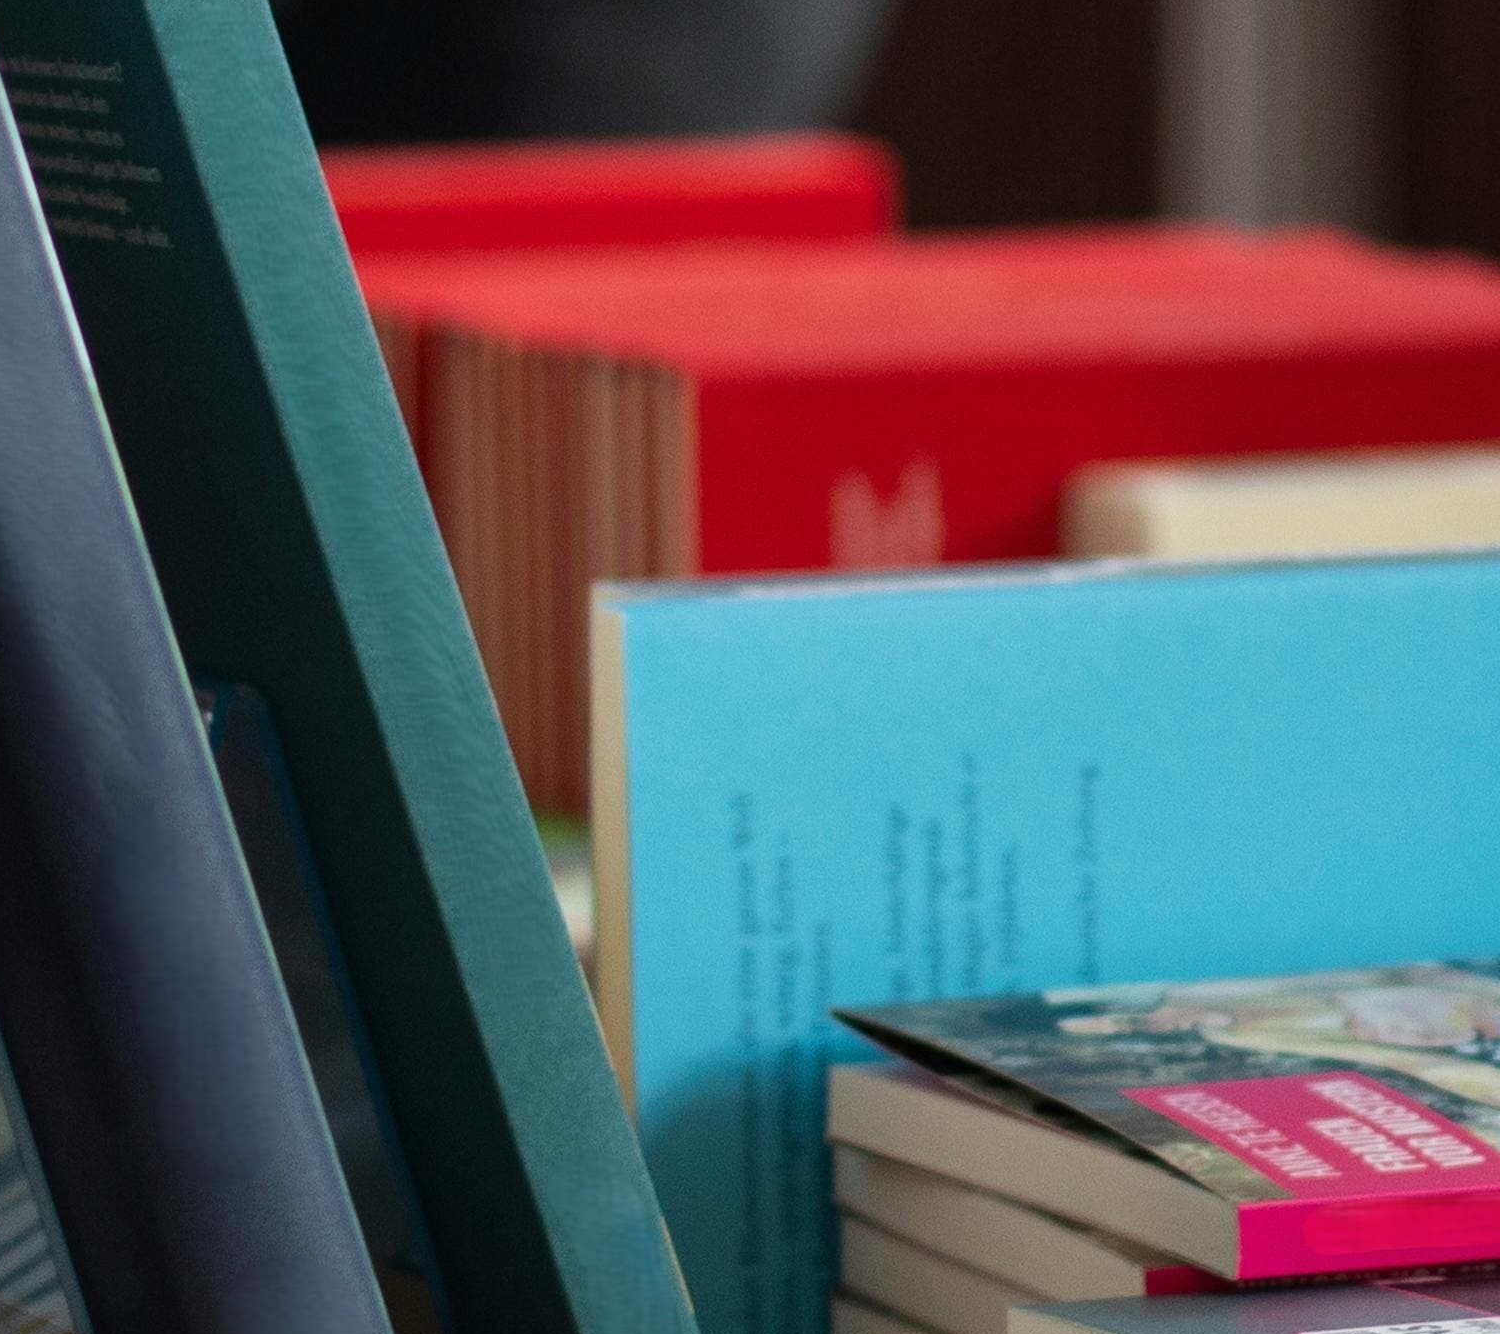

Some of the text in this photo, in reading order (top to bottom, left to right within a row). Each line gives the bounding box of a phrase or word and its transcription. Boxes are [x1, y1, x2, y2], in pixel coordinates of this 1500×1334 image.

[1229, 1127, 1288, 1147] TE
[1307, 1117, 1427, 1173] FRAUEN
[1408, 1134, 1487, 1168] VOR
[1251, 1140, 1342, 1179] ANKE
